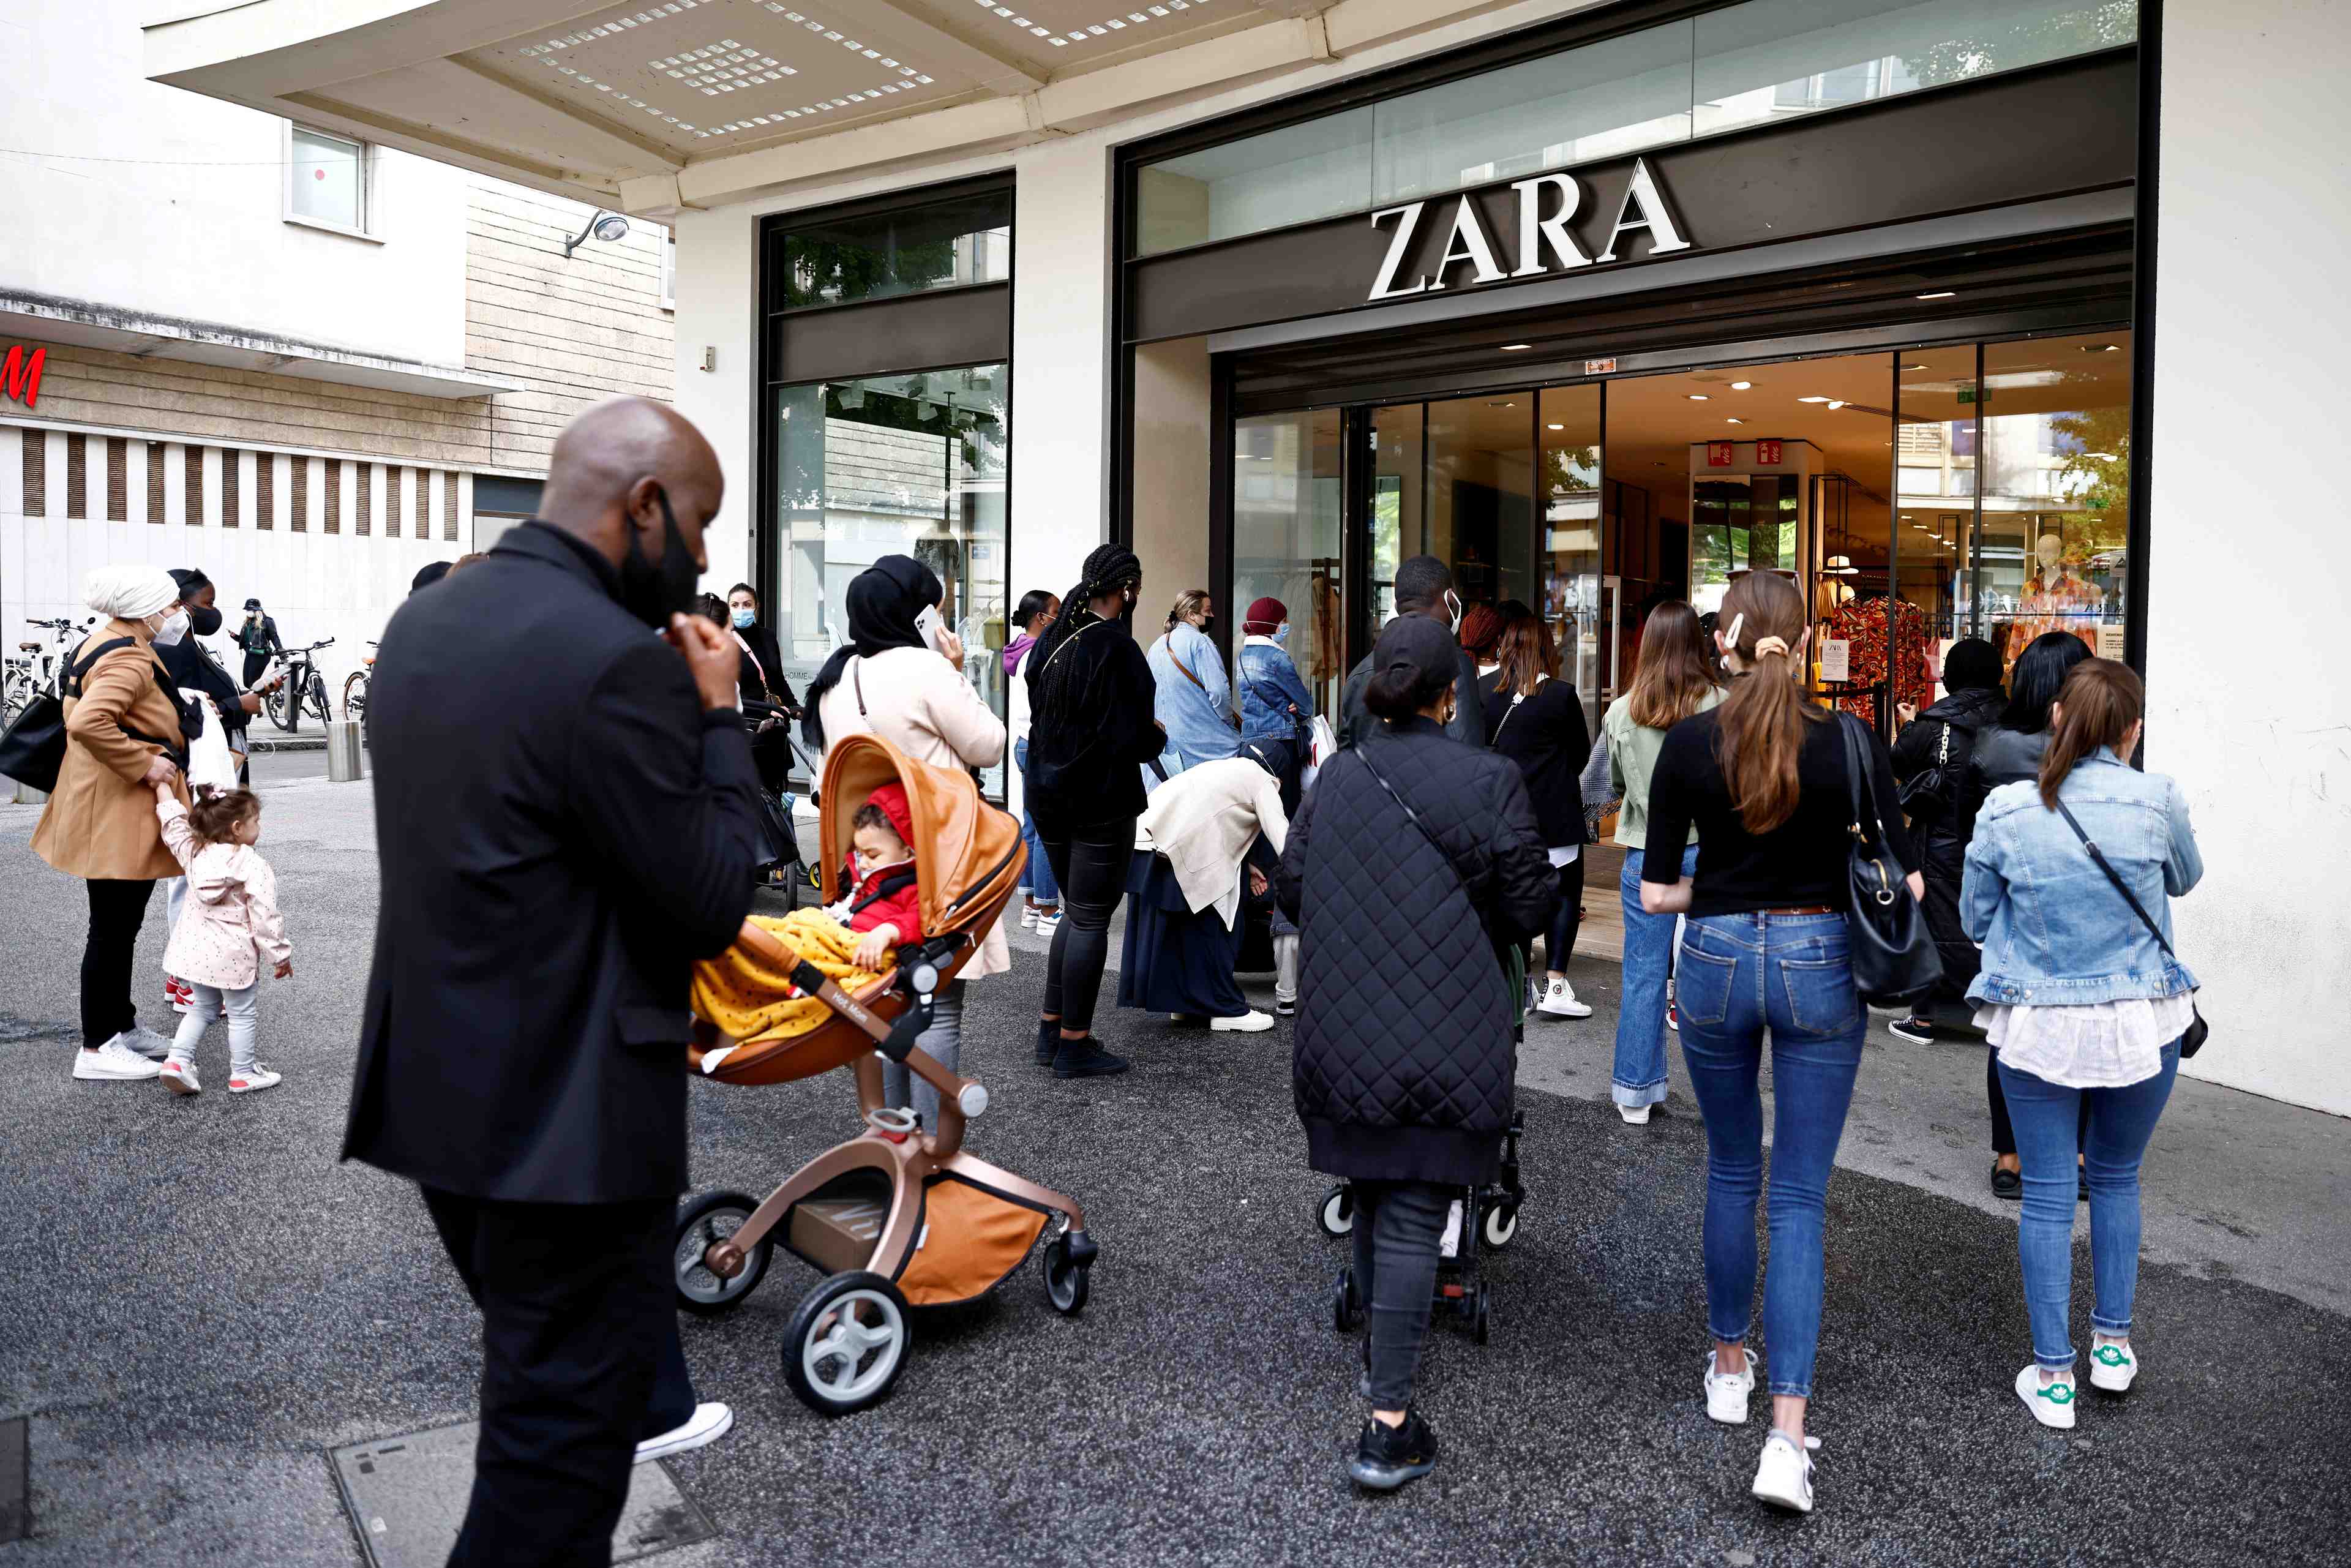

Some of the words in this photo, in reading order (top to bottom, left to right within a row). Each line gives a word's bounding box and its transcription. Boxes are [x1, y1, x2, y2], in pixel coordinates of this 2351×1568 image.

[1368, 157, 1691, 301] ZARA
[0, 345, 47, 409] M
[832, 991, 849, 1008] Hot
[848, 1003, 868, 1024] Mom
